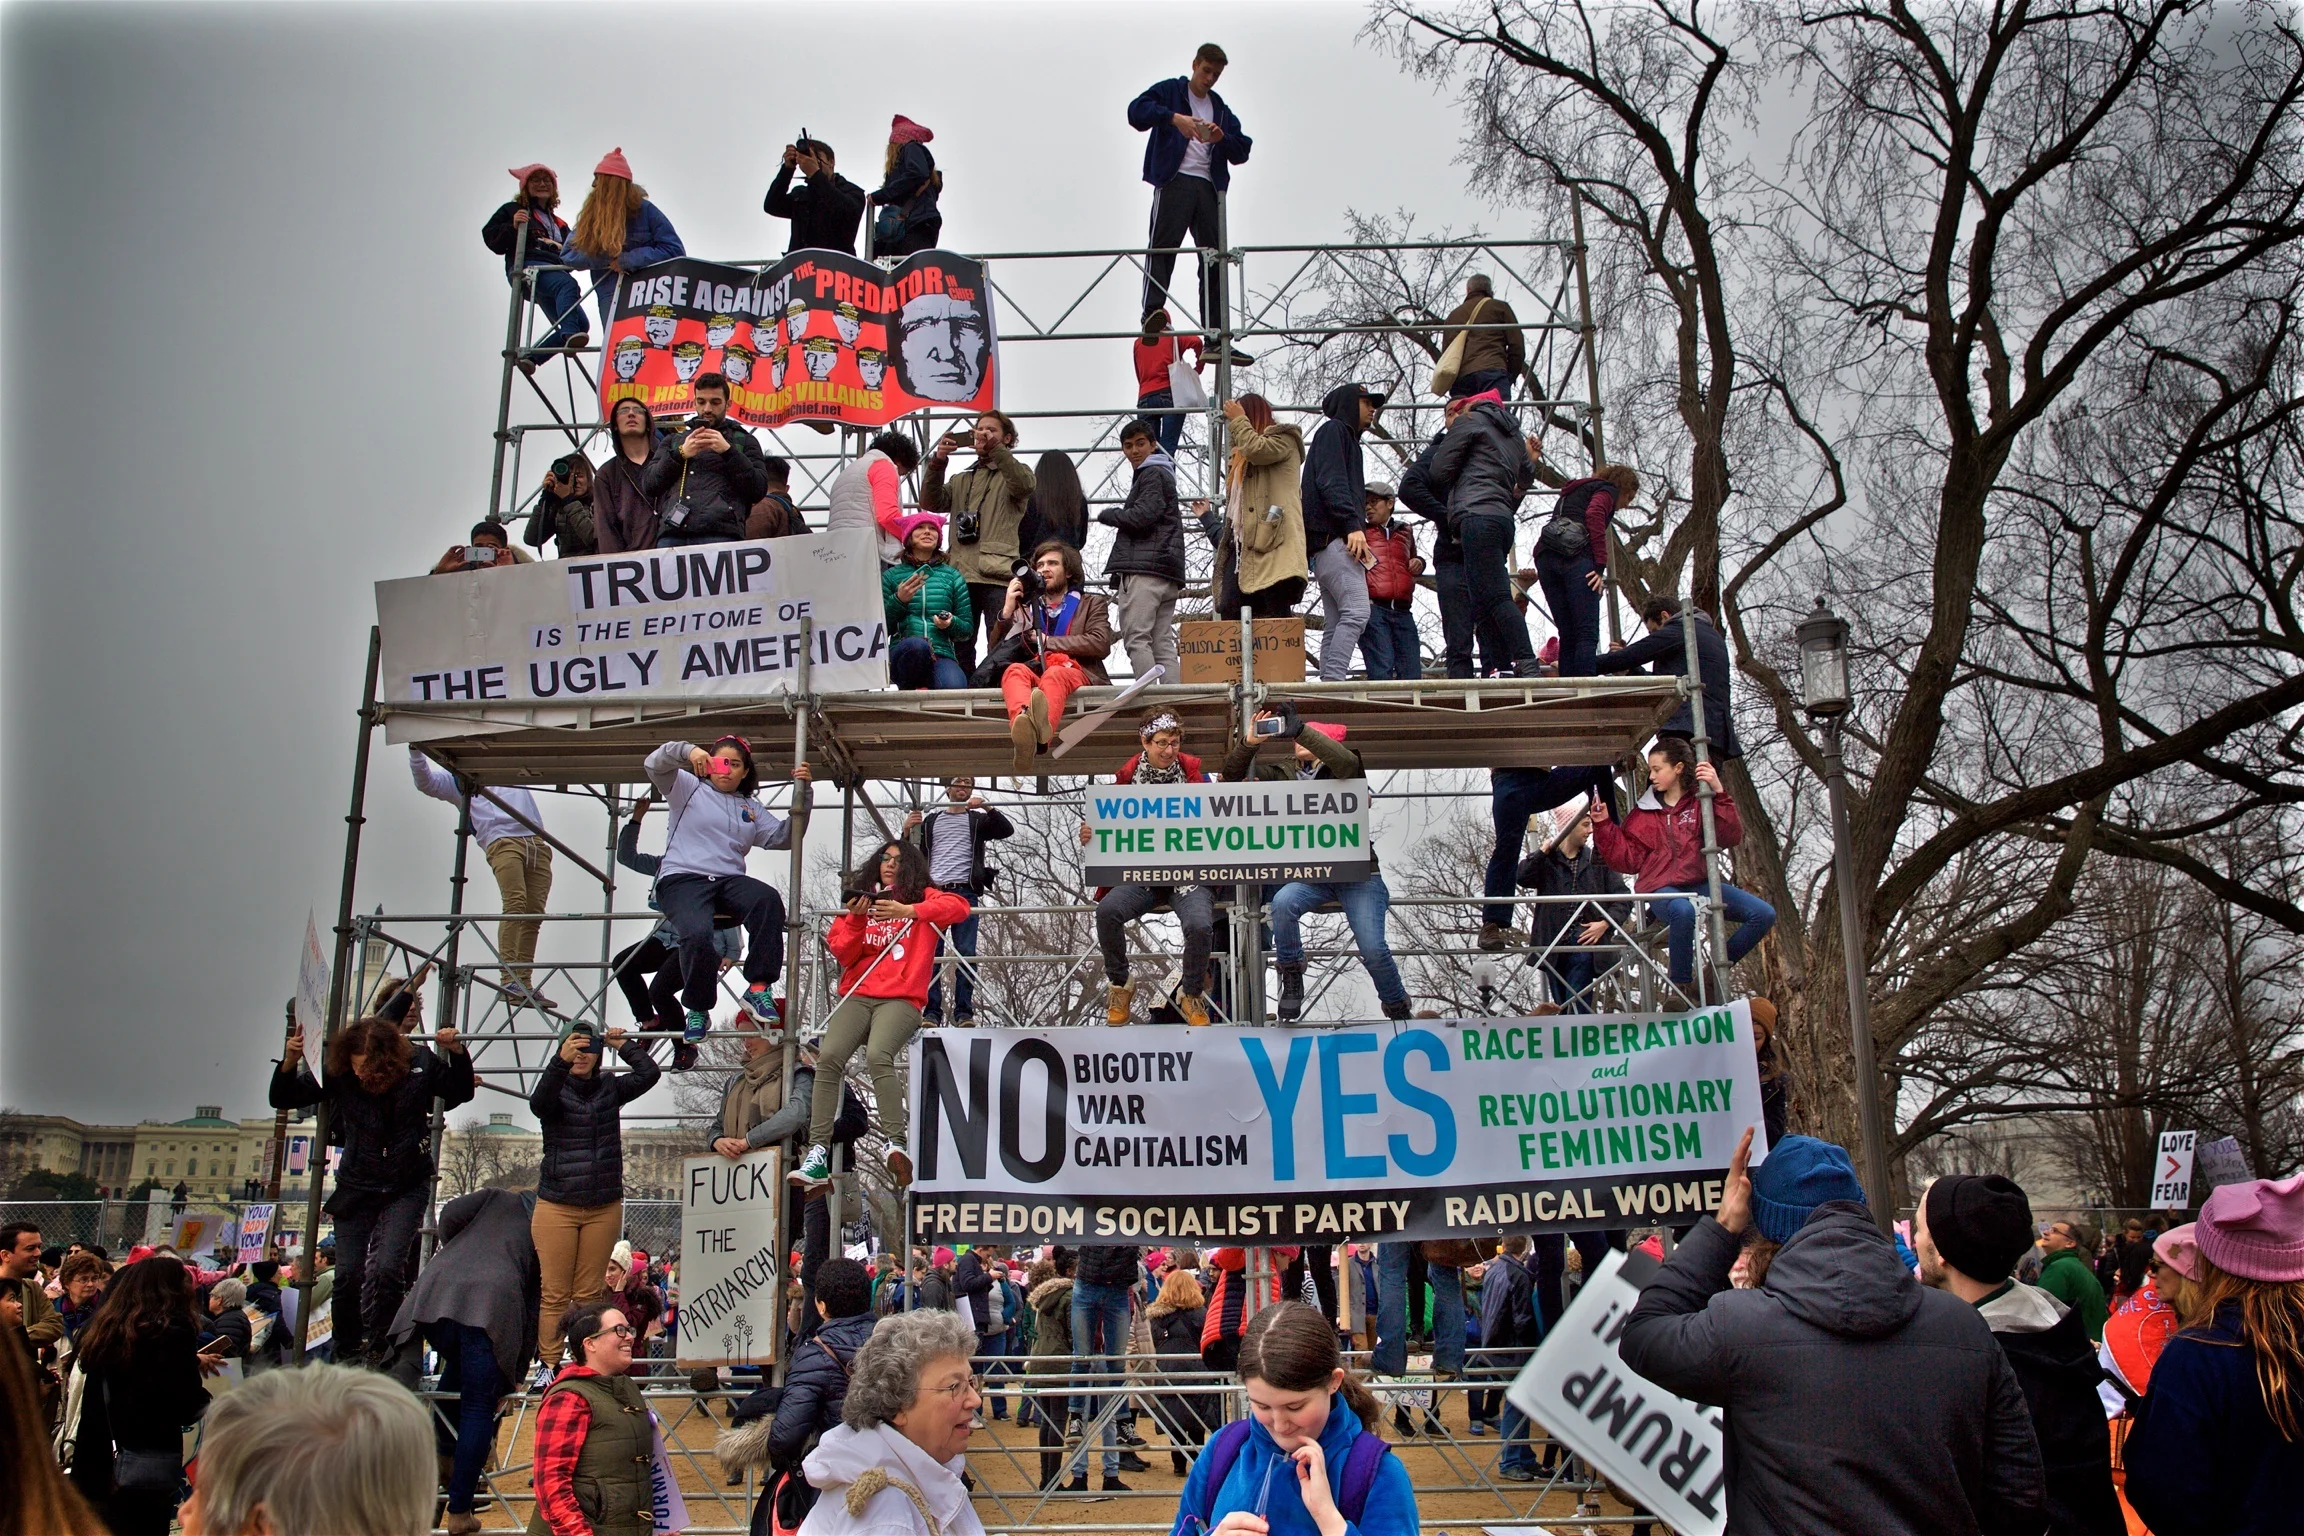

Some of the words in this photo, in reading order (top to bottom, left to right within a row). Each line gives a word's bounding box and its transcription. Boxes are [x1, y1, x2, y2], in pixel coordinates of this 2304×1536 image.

[628, 275, 689, 309] RISE
[693, 272, 794, 316] AGAINST
[793, 260, 816, 282] THE
[815, 266, 943, 314] PREDATOR
[944, 275, 958, 287] IN
[949, 287, 975, 301] CHIEF
[606, 383, 649, 402] AND
[654, 384, 689, 402] HIS
[728, 382, 792, 412] OMOUS
[795, 381, 884, 411] VILLAINS
[568, 547, 771, 610] TRUMP
[535, 627, 562, 648] IS
[577, 620, 630, 642] THE
[643, 607, 762, 636] EPITOME
[778, 602, 811, 621] OF
[1282, 636, 1300, 648] FOR
[412, 666, 507, 700] THE
[530, 649, 659, 697] UGLY
[1095, 796, 1201, 819] WOMEN
[1209, 794, 1278, 817] WILL
[1286, 792, 1358, 816] LEAD
[1095, 828, 1154, 852] THE
[1165, 823, 1360, 852] REVOLUTION
[1123, 869, 1194, 882] FREEDOM
[1199, 867, 1278, 881] SOCIALIST
[1284, 866, 1332, 879] PARTY
[1462, 1027, 1543, 1061] RACE
[1553, 1011, 1735, 1058] LIBERATION
[1074, 1051, 1194, 1083] BIGOTRY
[1591, 1057, 1629, 1080] and
[917, 1036, 1068, 1184] NO
[1078, 1094, 1146, 1125] WAR
[1239, 1029, 1457, 1181] YES
[1478, 1078, 1733, 1128] REVOLUTIONARY
[1074, 1134, 1248, 1167] CAPITALISM
[1518, 1121, 1702, 1170] FEMINISM
[2161, 1133, 2193, 1152] LOVE
[691, 1163, 770, 1207] FUCK
[2155, 1182, 2188, 1201] FEAR
[248, 1206, 273, 1219] YOUR
[915, 1204, 1084, 1235] FREEDOM
[1094, 1204, 1283, 1237] SOCIALIST
[1295, 1200, 1410, 1235] PARTY
[1445, 1187, 1605, 1227] RADICAL
[1611, 1180, 1721, 1216] WOME
[241, 1233, 264, 1248] YOUR
[243, 1220, 268, 1233] BODY
[696, 1228, 736, 1254] THE
[678, 1240, 777, 1342] PATRIARCHY
[1562, 1364, 1723, 1522] TRUMP
